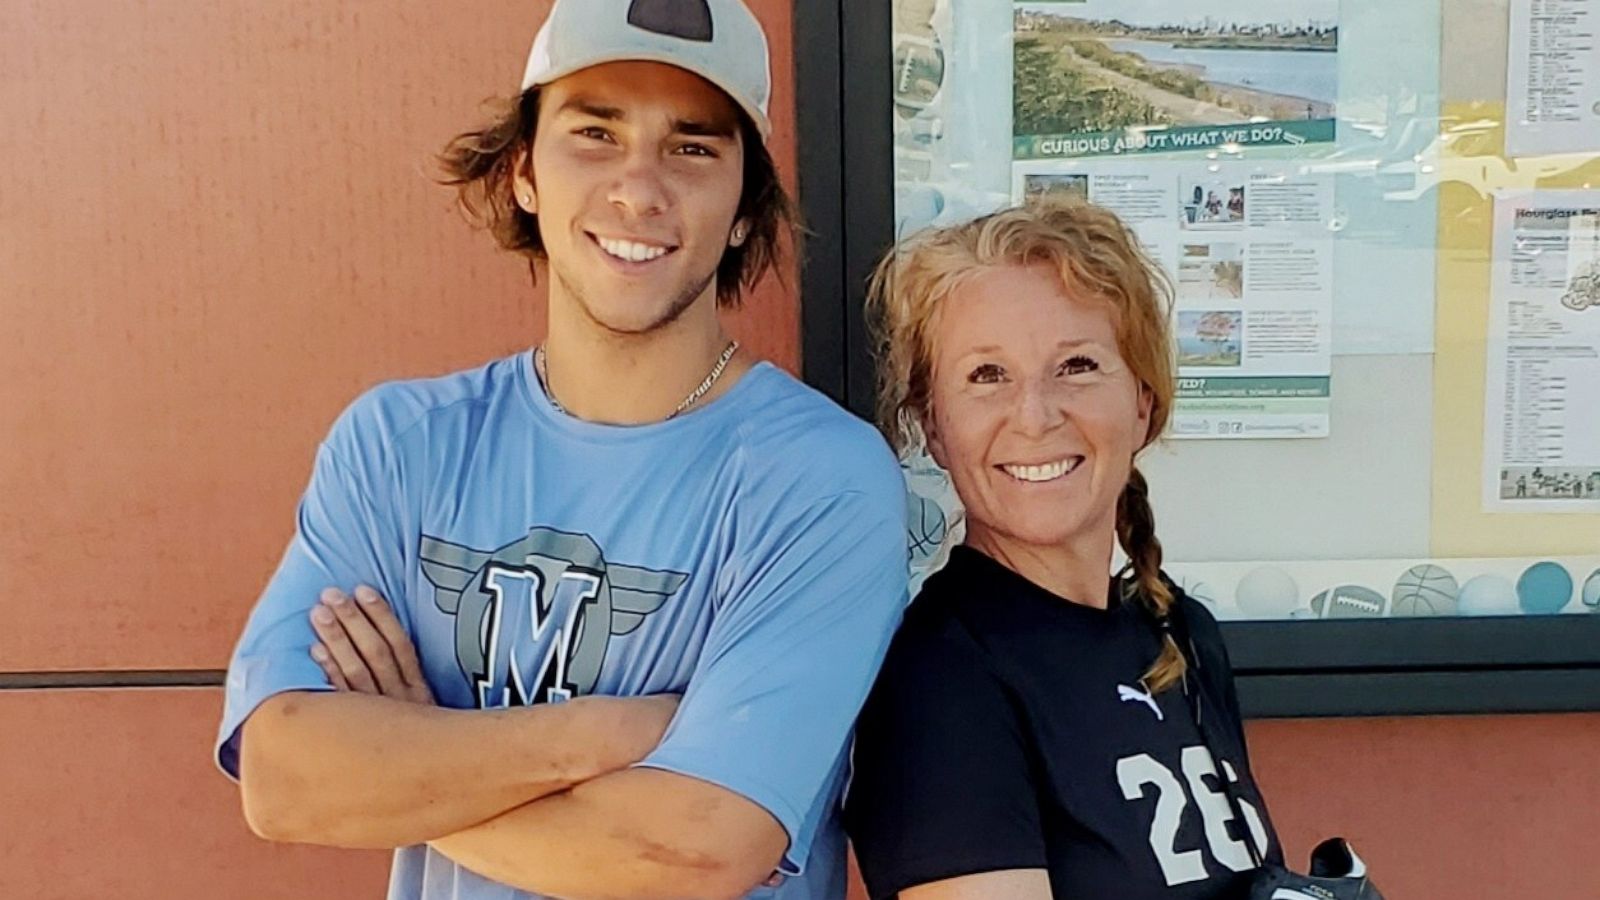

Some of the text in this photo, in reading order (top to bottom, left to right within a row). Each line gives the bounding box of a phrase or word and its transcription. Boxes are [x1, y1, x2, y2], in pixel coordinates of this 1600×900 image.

[1041, 128, 1283, 154] CURIOUS ABOUT WHAT WE DO?
[473, 562, 602, 710] M
[1116, 746, 1268, 886] 26
